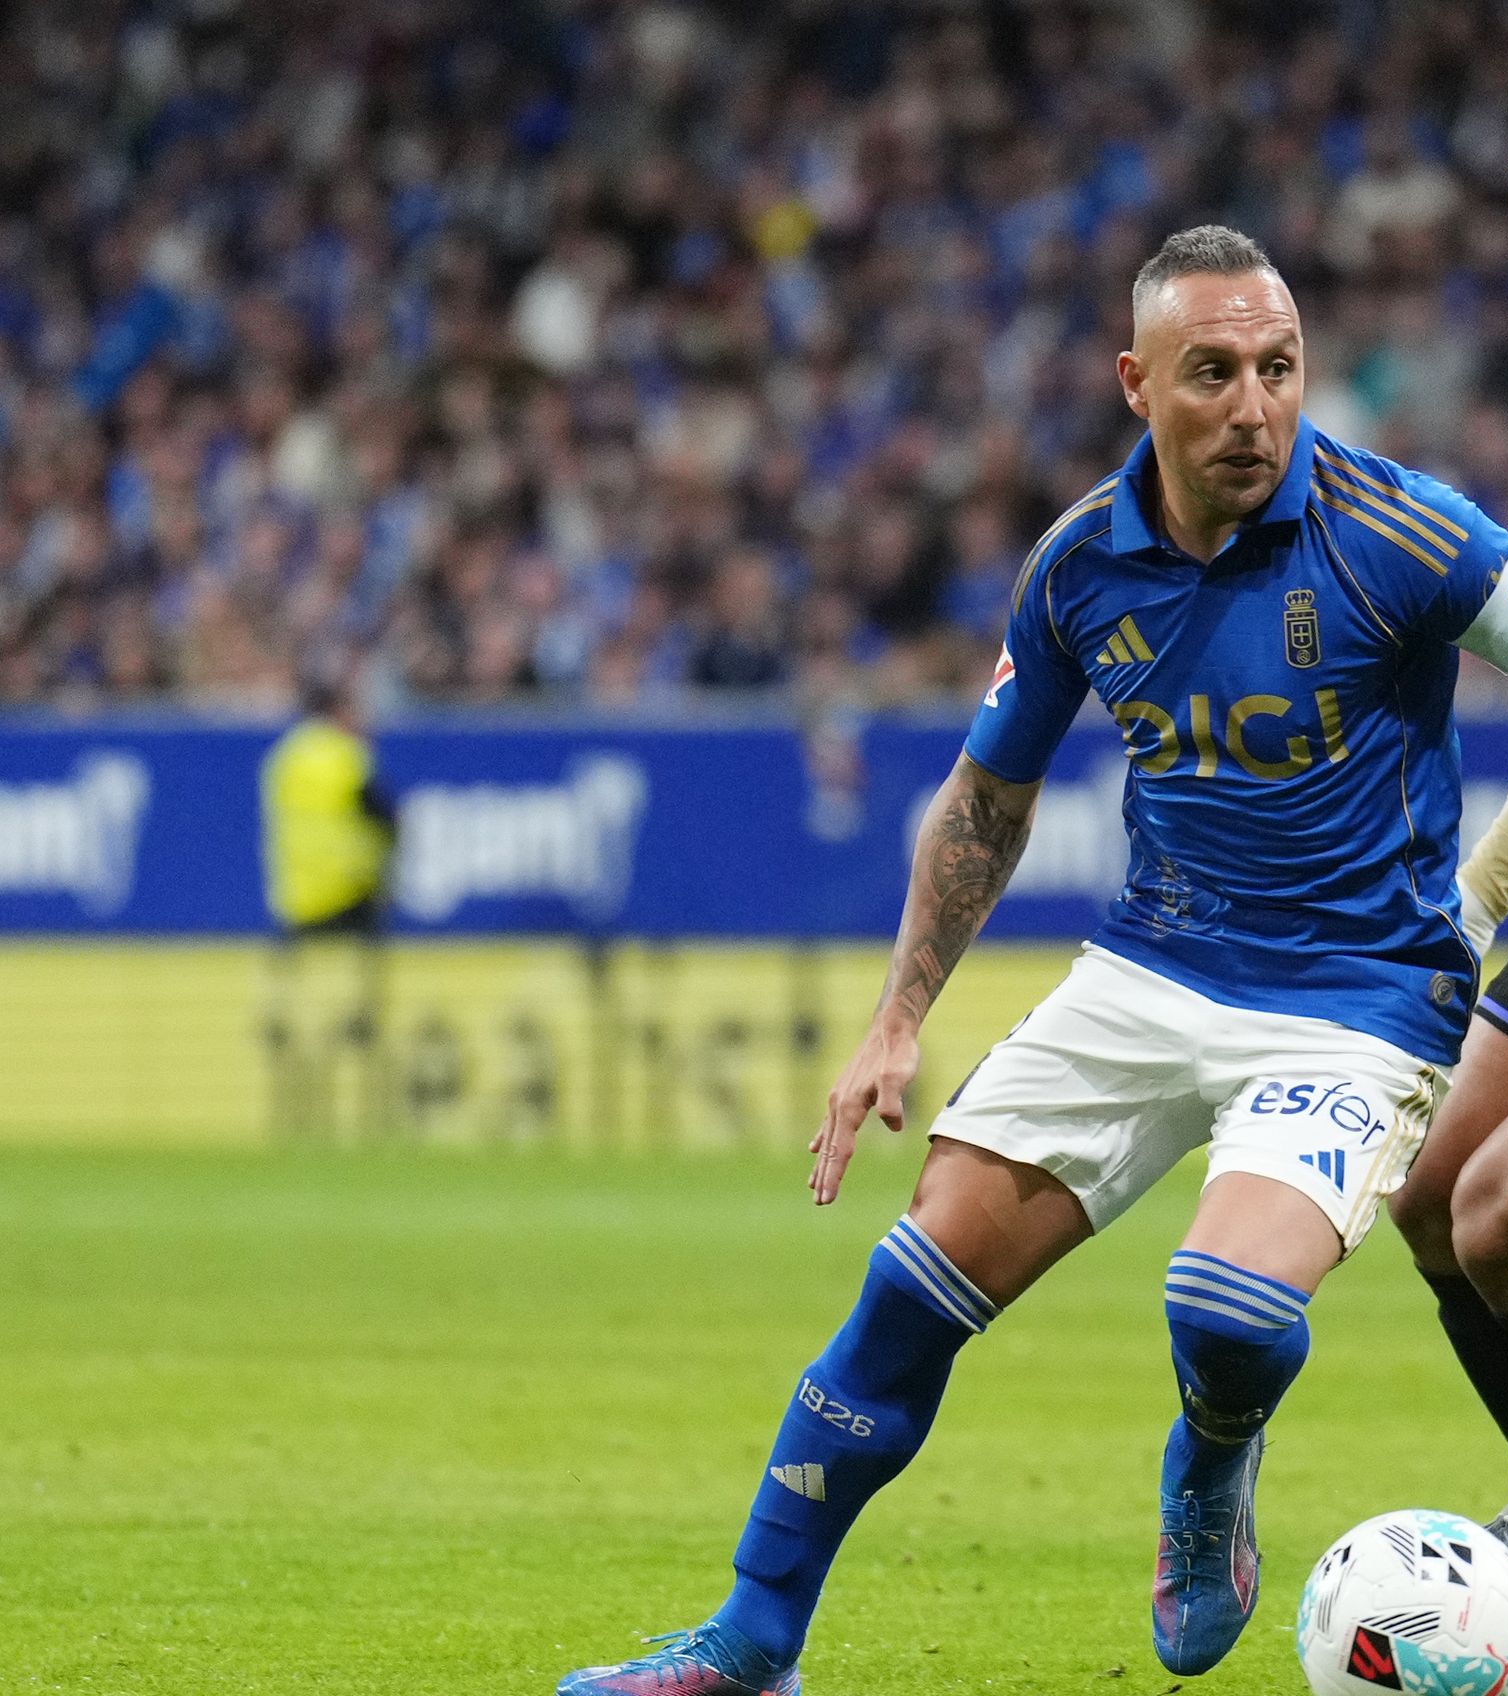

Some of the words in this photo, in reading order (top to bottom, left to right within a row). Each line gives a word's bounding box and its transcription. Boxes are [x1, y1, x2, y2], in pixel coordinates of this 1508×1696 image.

[1112, 689, 1350, 780] DIGI
[1250, 1080, 1386, 1145] esfer
[799, 1378, 875, 1437] 1926
